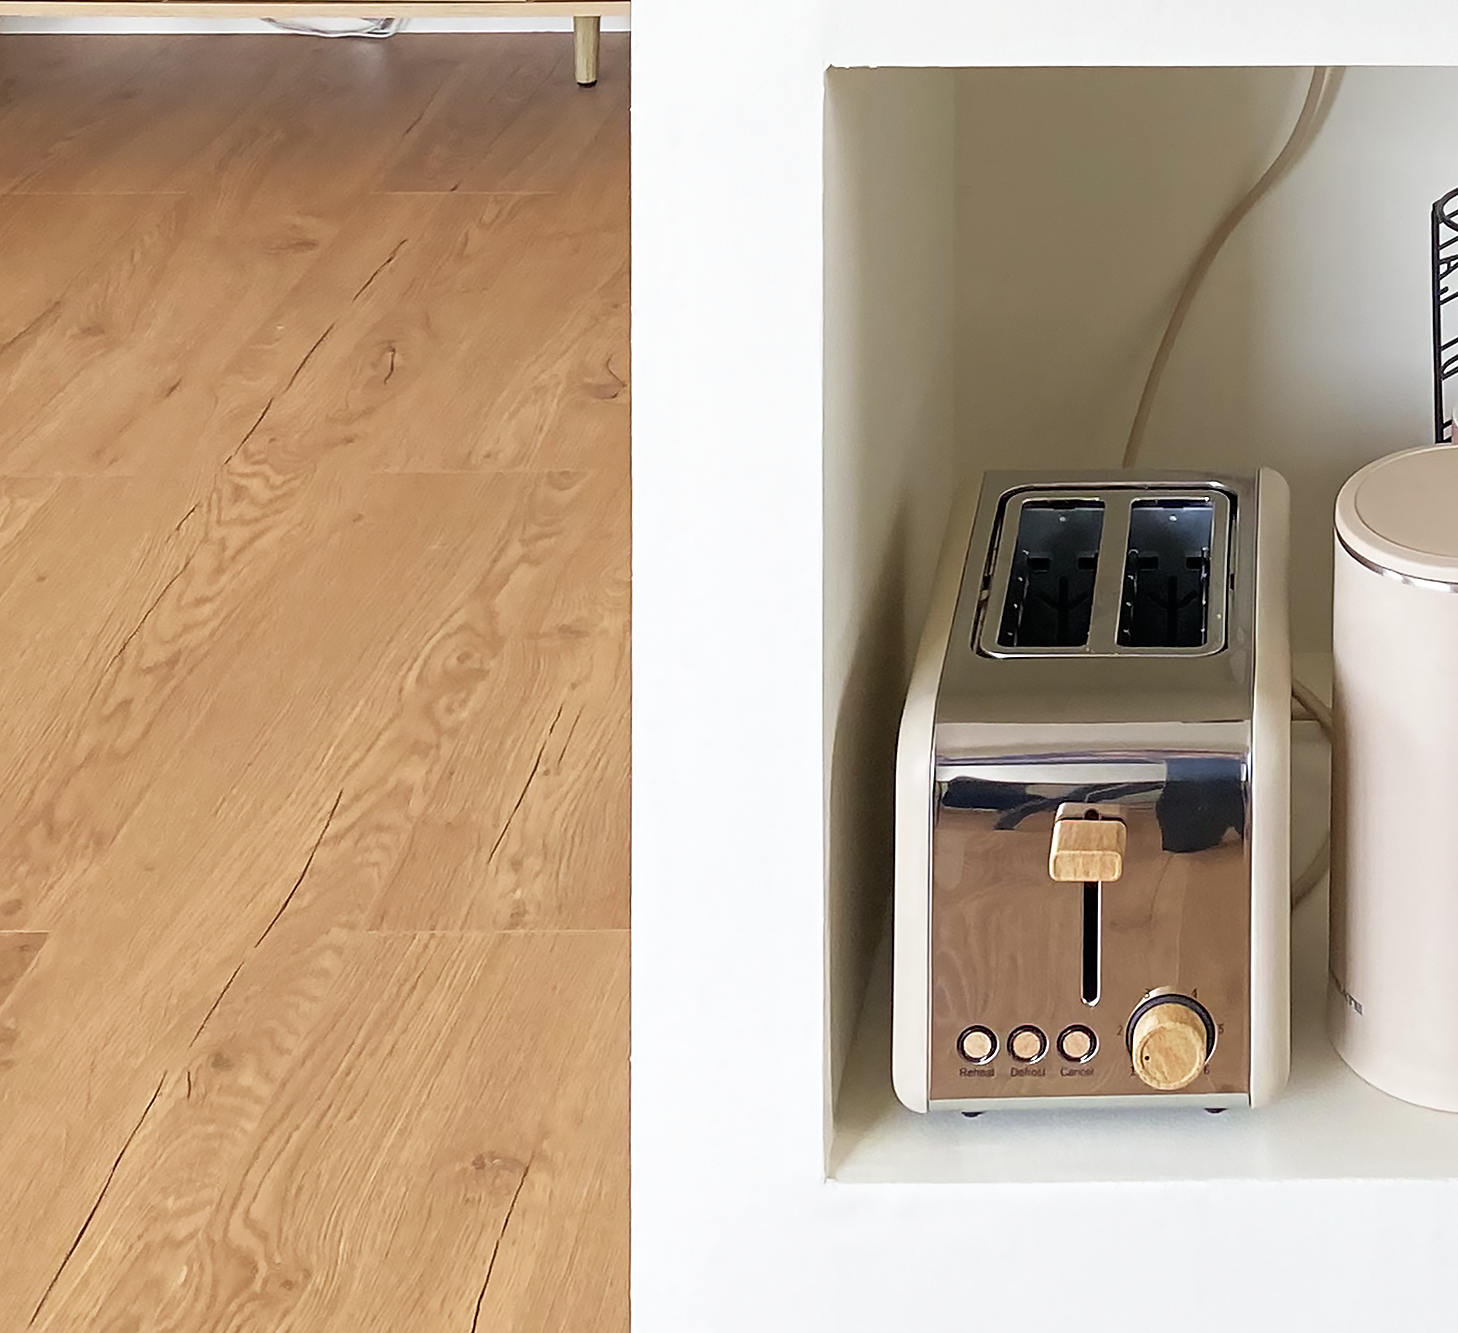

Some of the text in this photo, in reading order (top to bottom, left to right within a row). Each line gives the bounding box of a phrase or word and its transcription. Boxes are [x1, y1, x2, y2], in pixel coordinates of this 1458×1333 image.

[959, 1067, 995, 1077] Reheat
[1010, 1067, 1046, 1077] Defrost
[1059, 1067, 1095, 1077] Cancel
